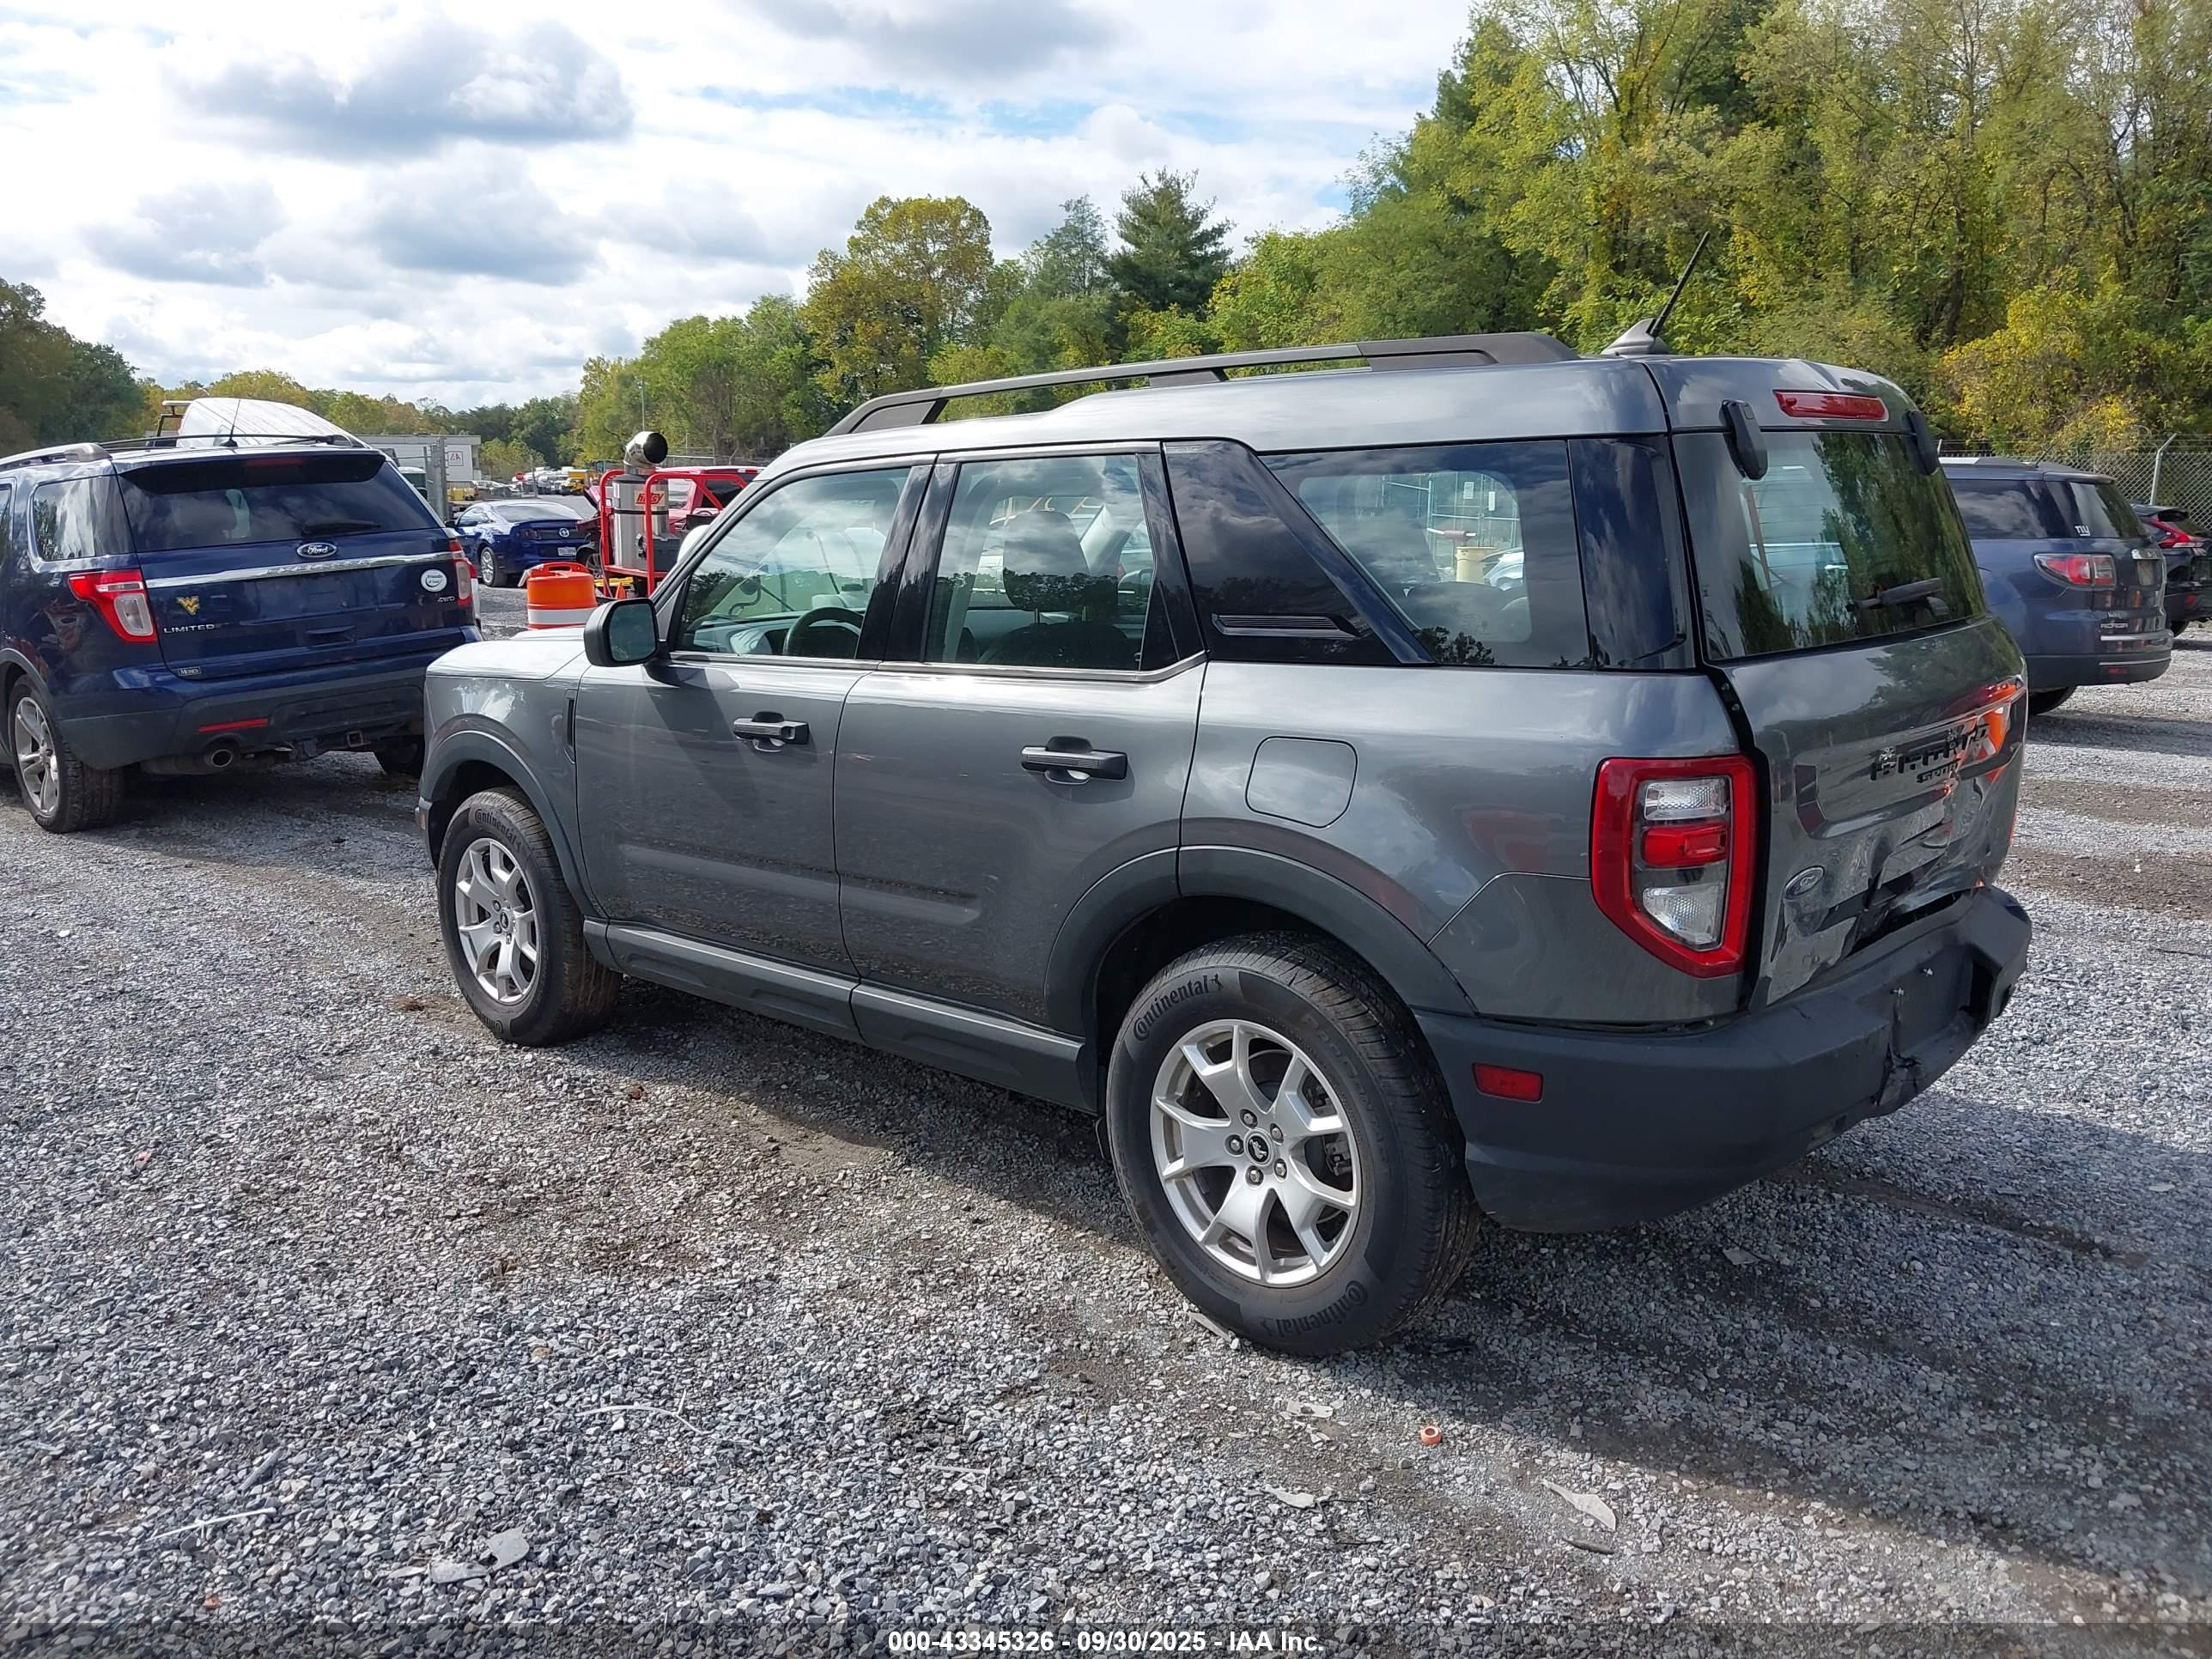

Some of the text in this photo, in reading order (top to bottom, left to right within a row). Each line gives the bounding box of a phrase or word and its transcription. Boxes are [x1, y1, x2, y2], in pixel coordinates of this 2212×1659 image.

[163, 623, 216, 634] LIMITED
[474, 808, 517, 845] Continental
[1133, 975, 1210, 1042] Continental
[1275, 1279, 1369, 1337] Continental
